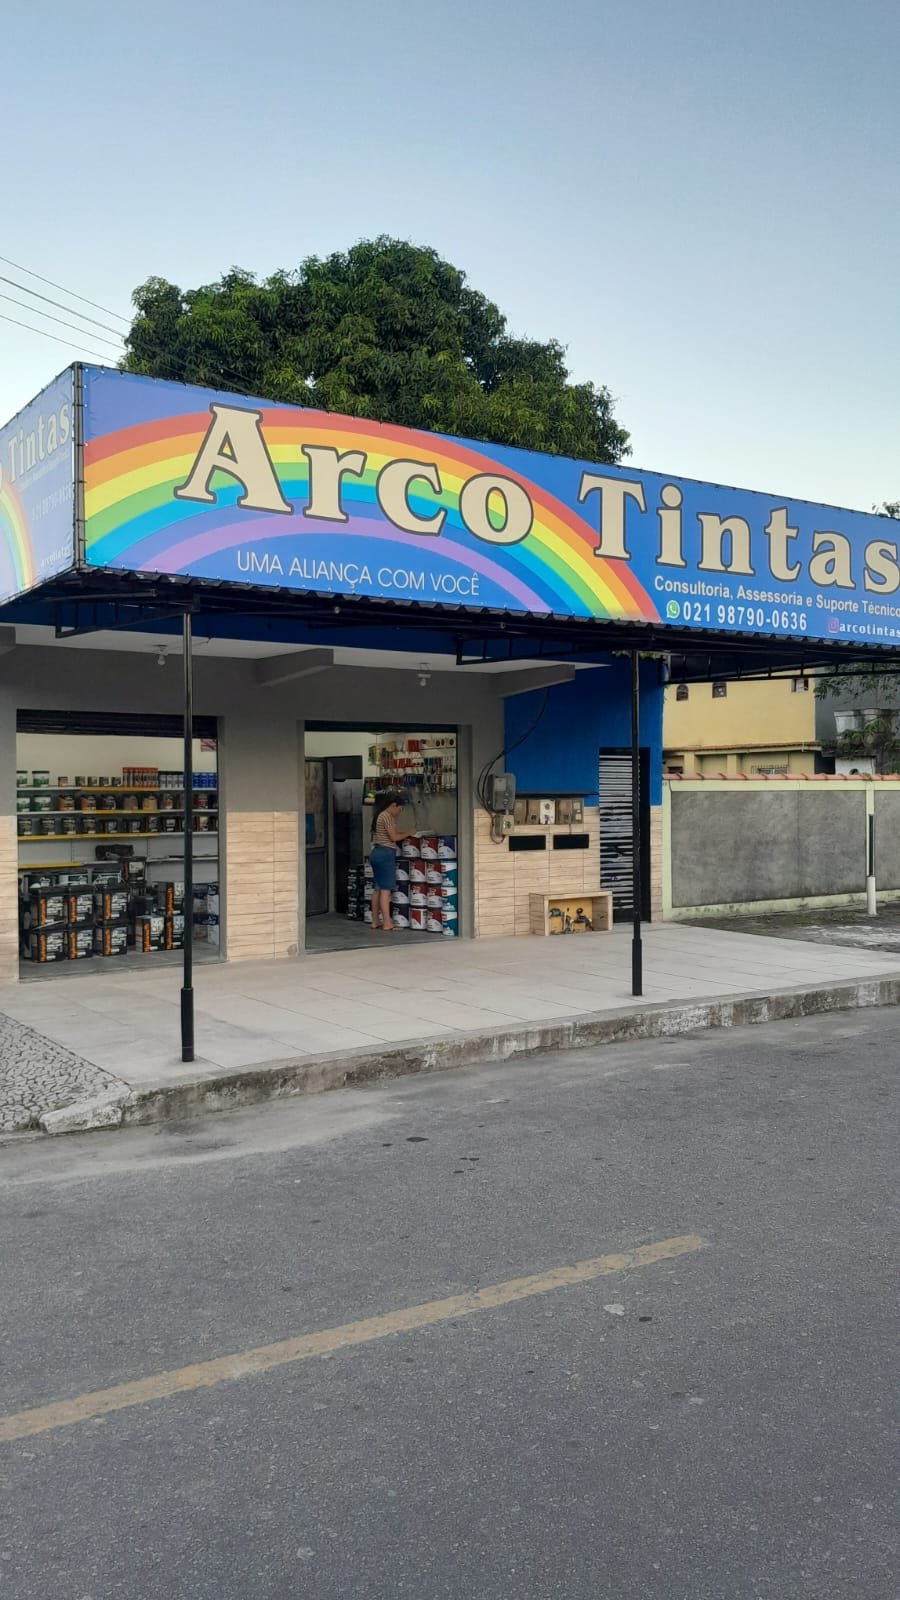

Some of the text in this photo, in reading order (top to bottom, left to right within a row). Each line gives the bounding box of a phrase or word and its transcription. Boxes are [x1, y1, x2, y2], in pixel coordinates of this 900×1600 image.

[8, 402, 70, 482] Tintas
[173, 402, 900, 595] Arco Tintas
[236, 550, 480, 596] UMA ALIANÇA COM VOCÊ
[654, 575, 900, 617] Consultoria, Assessoria e Suporte Técnico
[683, 601, 807, 631] 021 98790-0636
[839, 623, 900, 638] arcotintas
